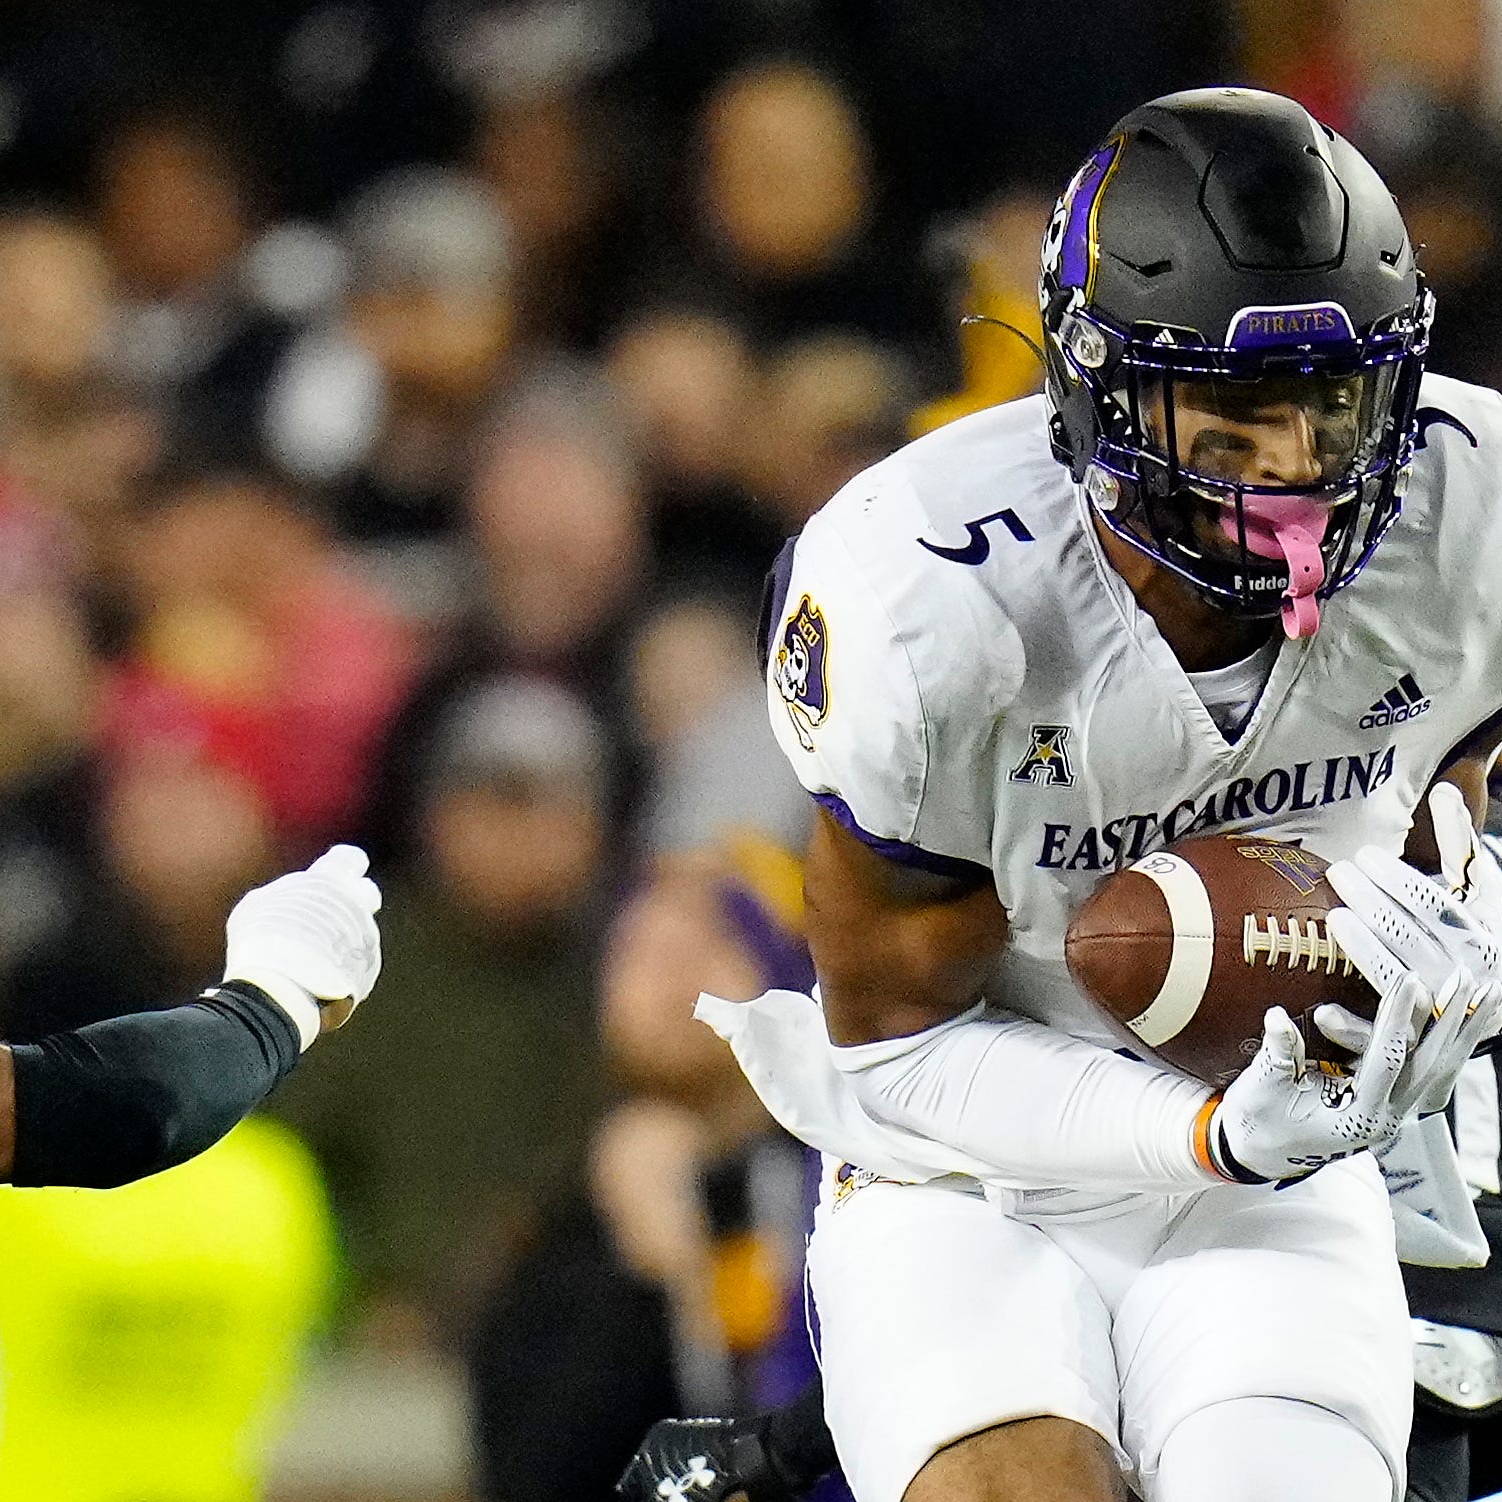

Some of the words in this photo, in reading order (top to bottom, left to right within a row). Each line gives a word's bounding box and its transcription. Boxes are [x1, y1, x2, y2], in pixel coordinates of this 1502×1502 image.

[1248, 310, 1337, 336] PIRATES
[915, 506, 1037, 567] 5
[798, 612, 821, 647] ECU
[1358, 698, 1432, 730] adidas
[1035, 812, 1159, 871] EAST
[1161, 745, 1397, 845] CAROLINA
